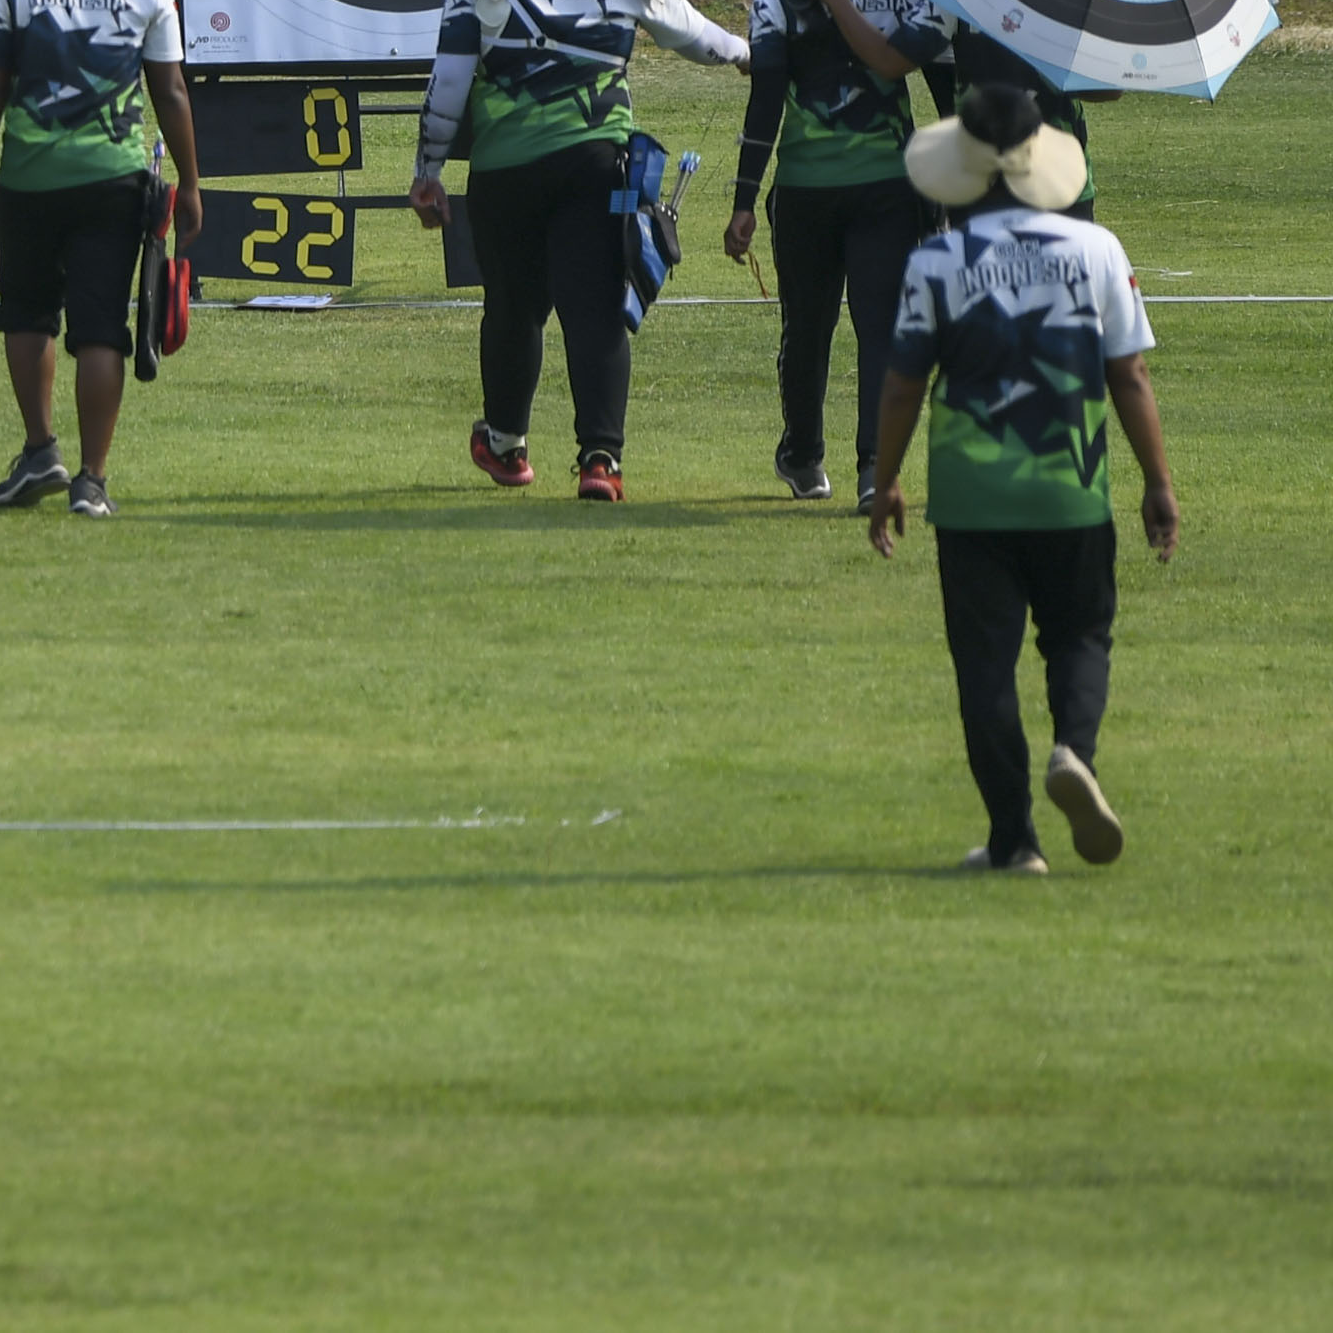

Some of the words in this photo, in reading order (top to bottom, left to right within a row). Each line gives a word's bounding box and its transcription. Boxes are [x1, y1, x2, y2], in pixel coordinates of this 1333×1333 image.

[302, 87, 352, 166] 0
[241, 196, 345, 279] 22
[994, 239, 1042, 258] COACH
[957, 254, 1083, 297] INDONESIA
